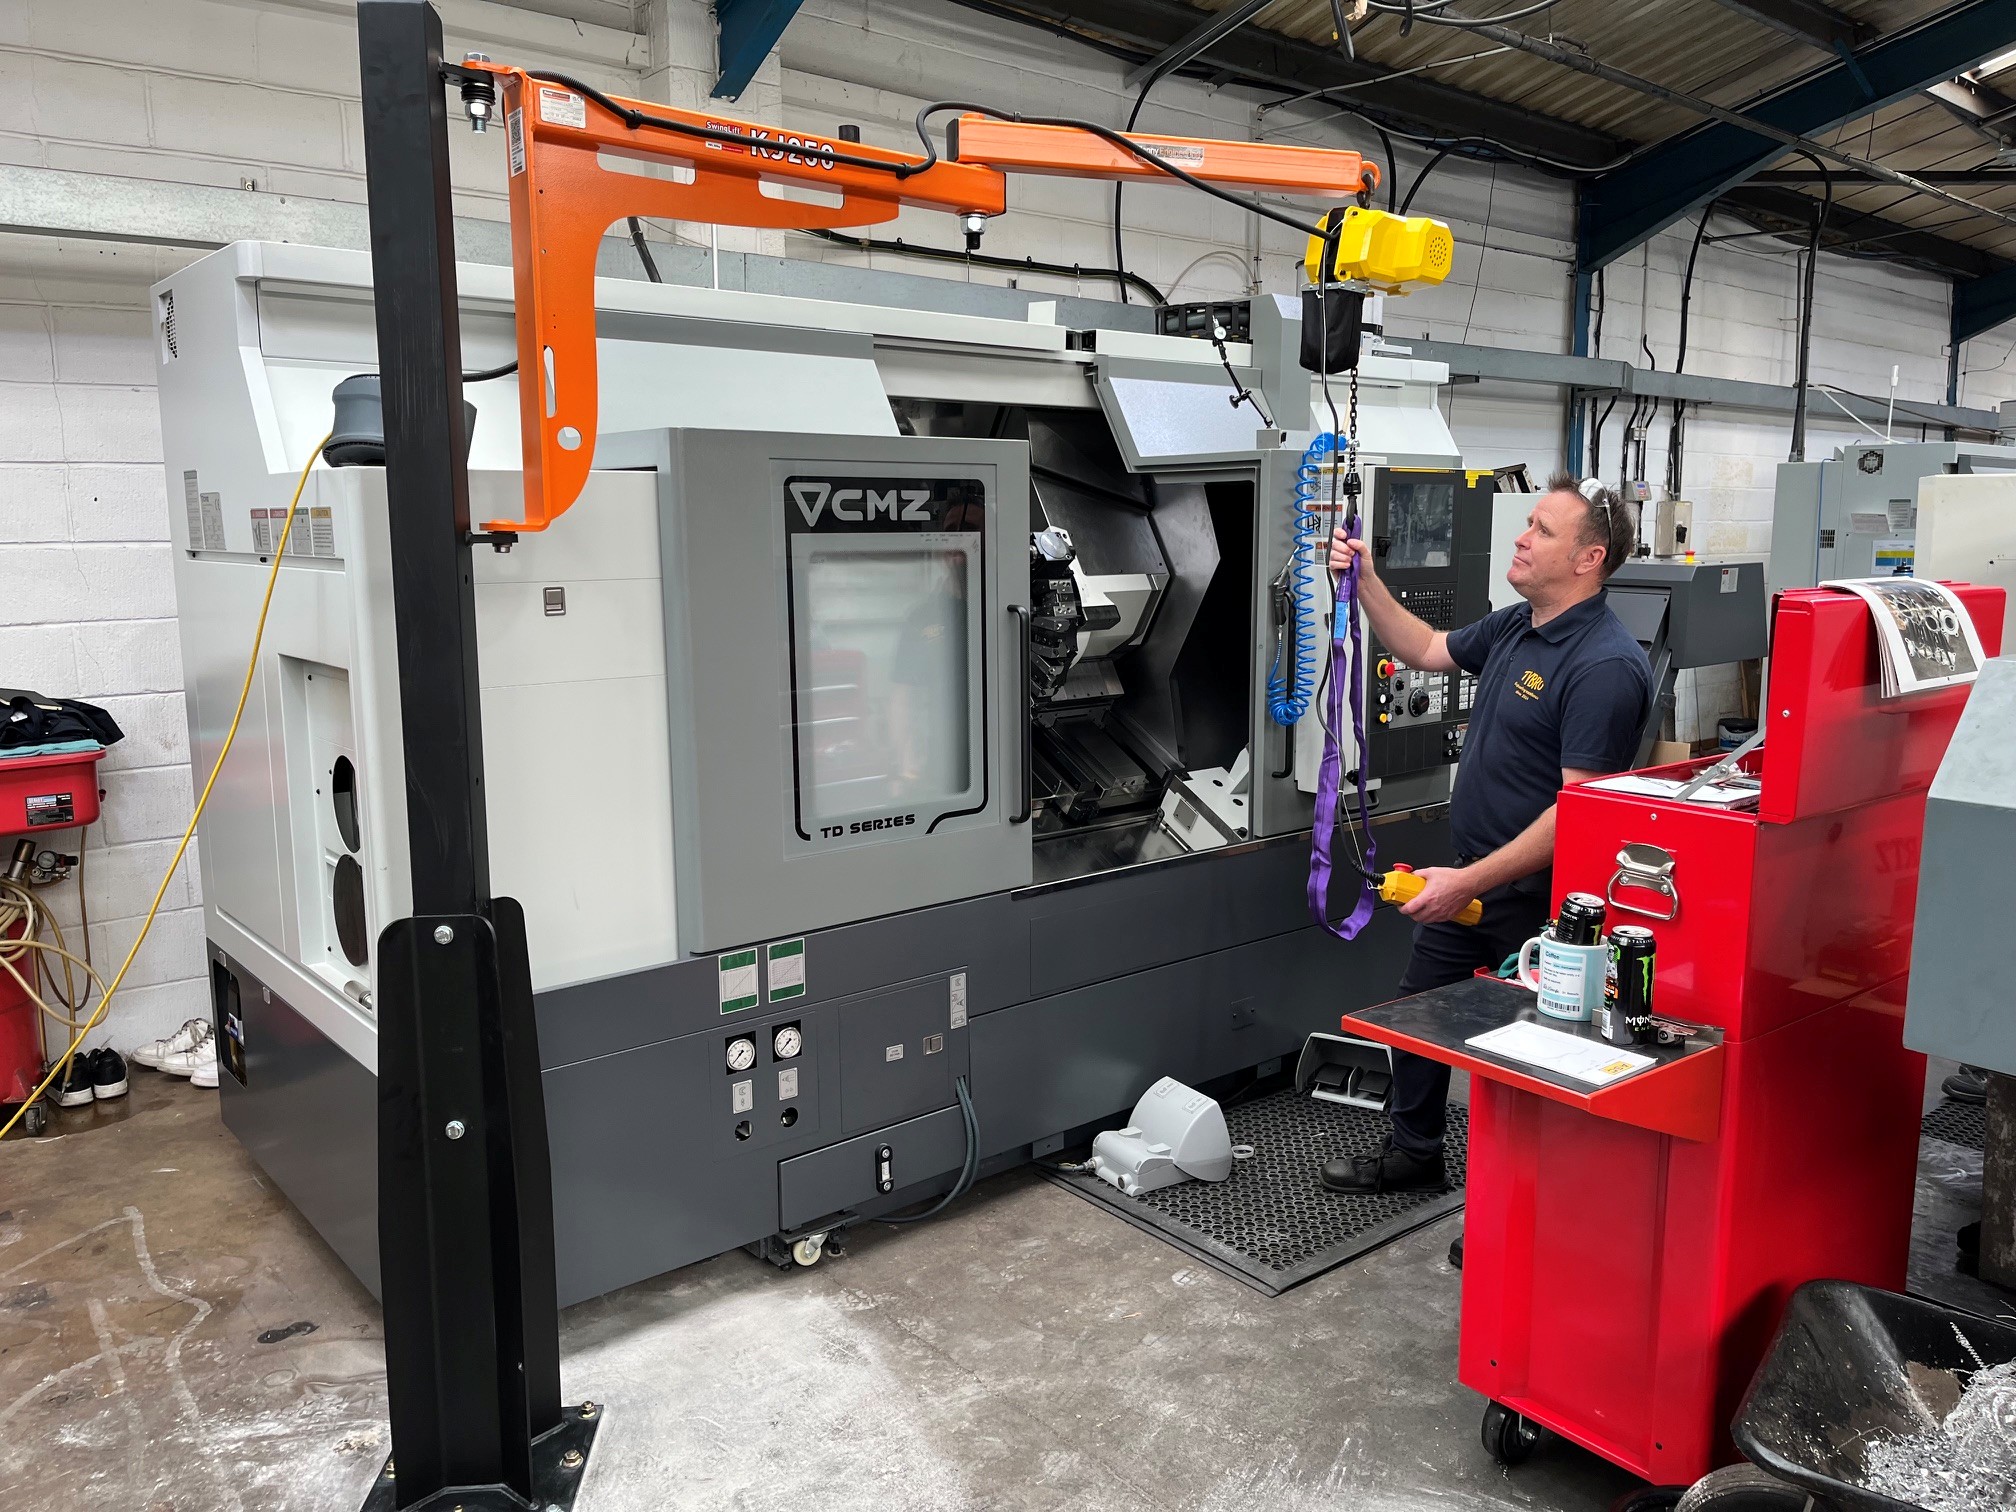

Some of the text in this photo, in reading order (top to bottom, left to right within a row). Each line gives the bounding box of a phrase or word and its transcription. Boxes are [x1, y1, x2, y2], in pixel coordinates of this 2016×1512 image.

[831, 489, 931, 522] CMZ
[1521, 670, 1544, 691] TYBRO
[820, 813, 916, 839] TD SERIES
